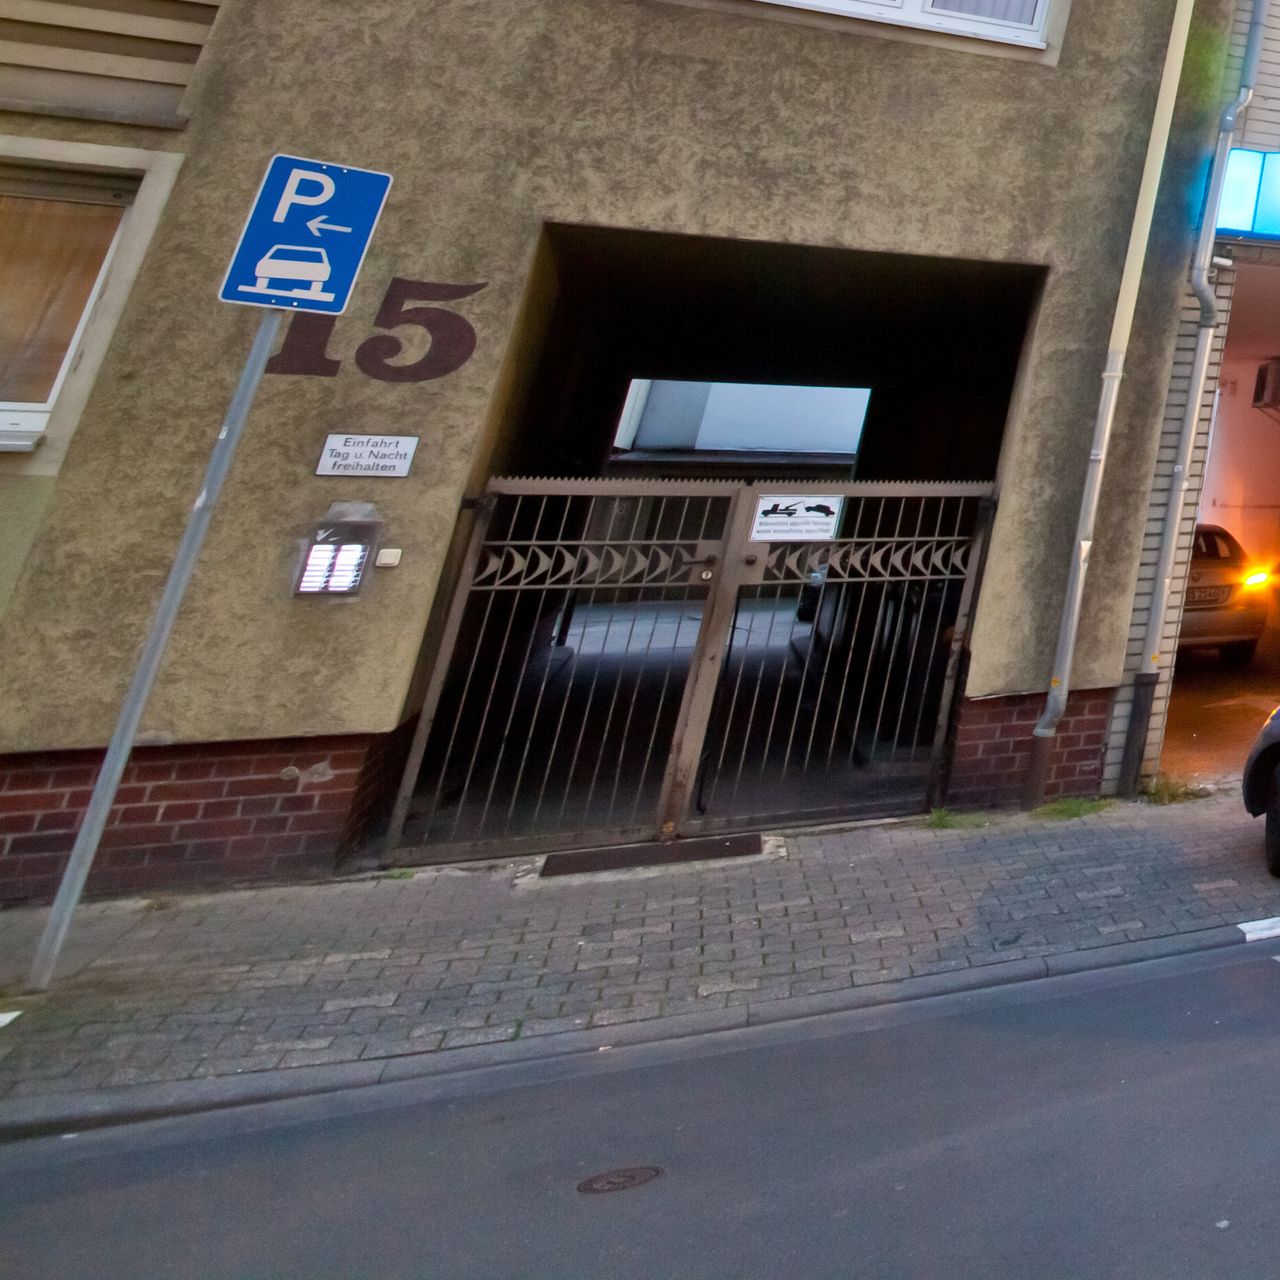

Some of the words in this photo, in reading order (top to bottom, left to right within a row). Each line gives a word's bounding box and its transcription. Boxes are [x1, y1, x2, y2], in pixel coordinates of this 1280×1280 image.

[273, 168, 336, 223] P
[264, 276, 490, 383] 15
[343, 437, 400, 448] Einfahrt
[329, 448, 350, 460] Tag
[368, 450, 408, 460] Nacht
[331, 461, 396, 472] freihalten
